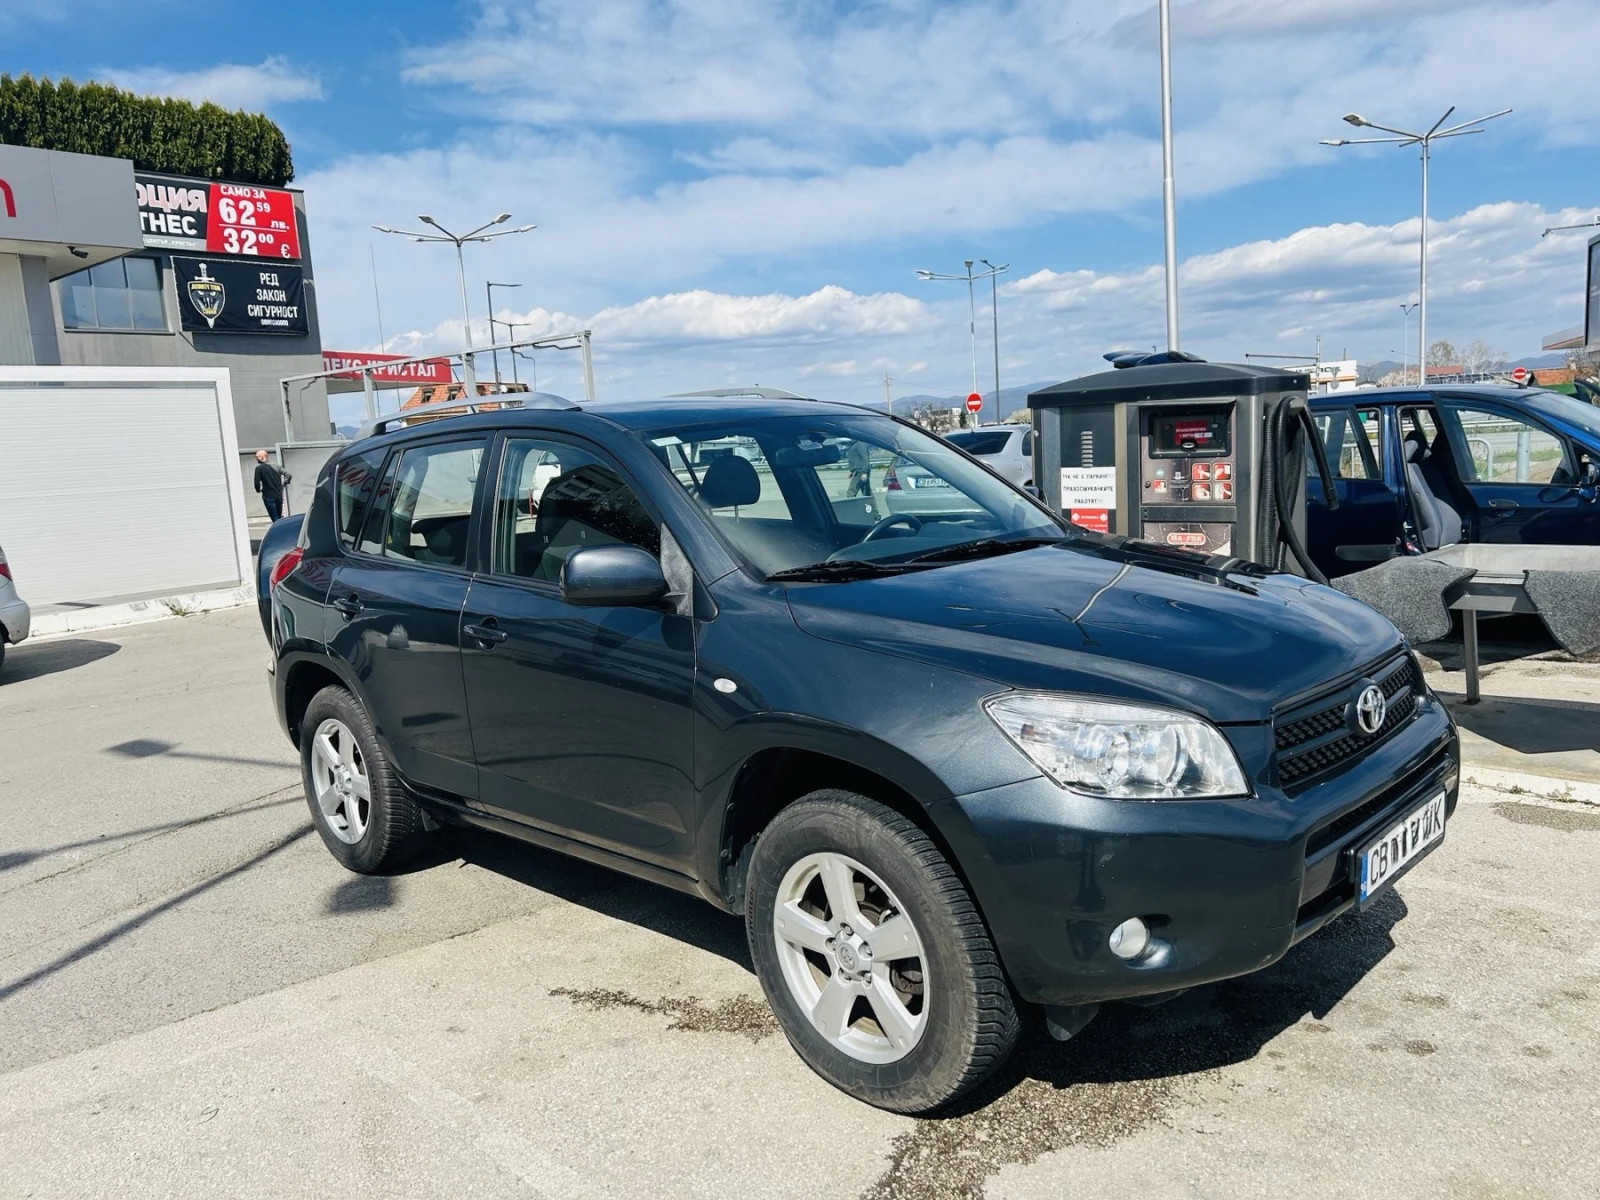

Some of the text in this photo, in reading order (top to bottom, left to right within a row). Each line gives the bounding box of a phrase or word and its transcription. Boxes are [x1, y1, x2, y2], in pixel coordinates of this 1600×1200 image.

[220, 185, 267, 199] САМО ЗА
[218, 198, 256, 226] 62
[256, 201, 271, 213] 59
[223, 228, 258, 255] 32
[259, 272, 279, 286] РЕД
[256, 288, 286, 302] ЗАКОН
[247, 304, 298, 318] СИГУРНОСТ
